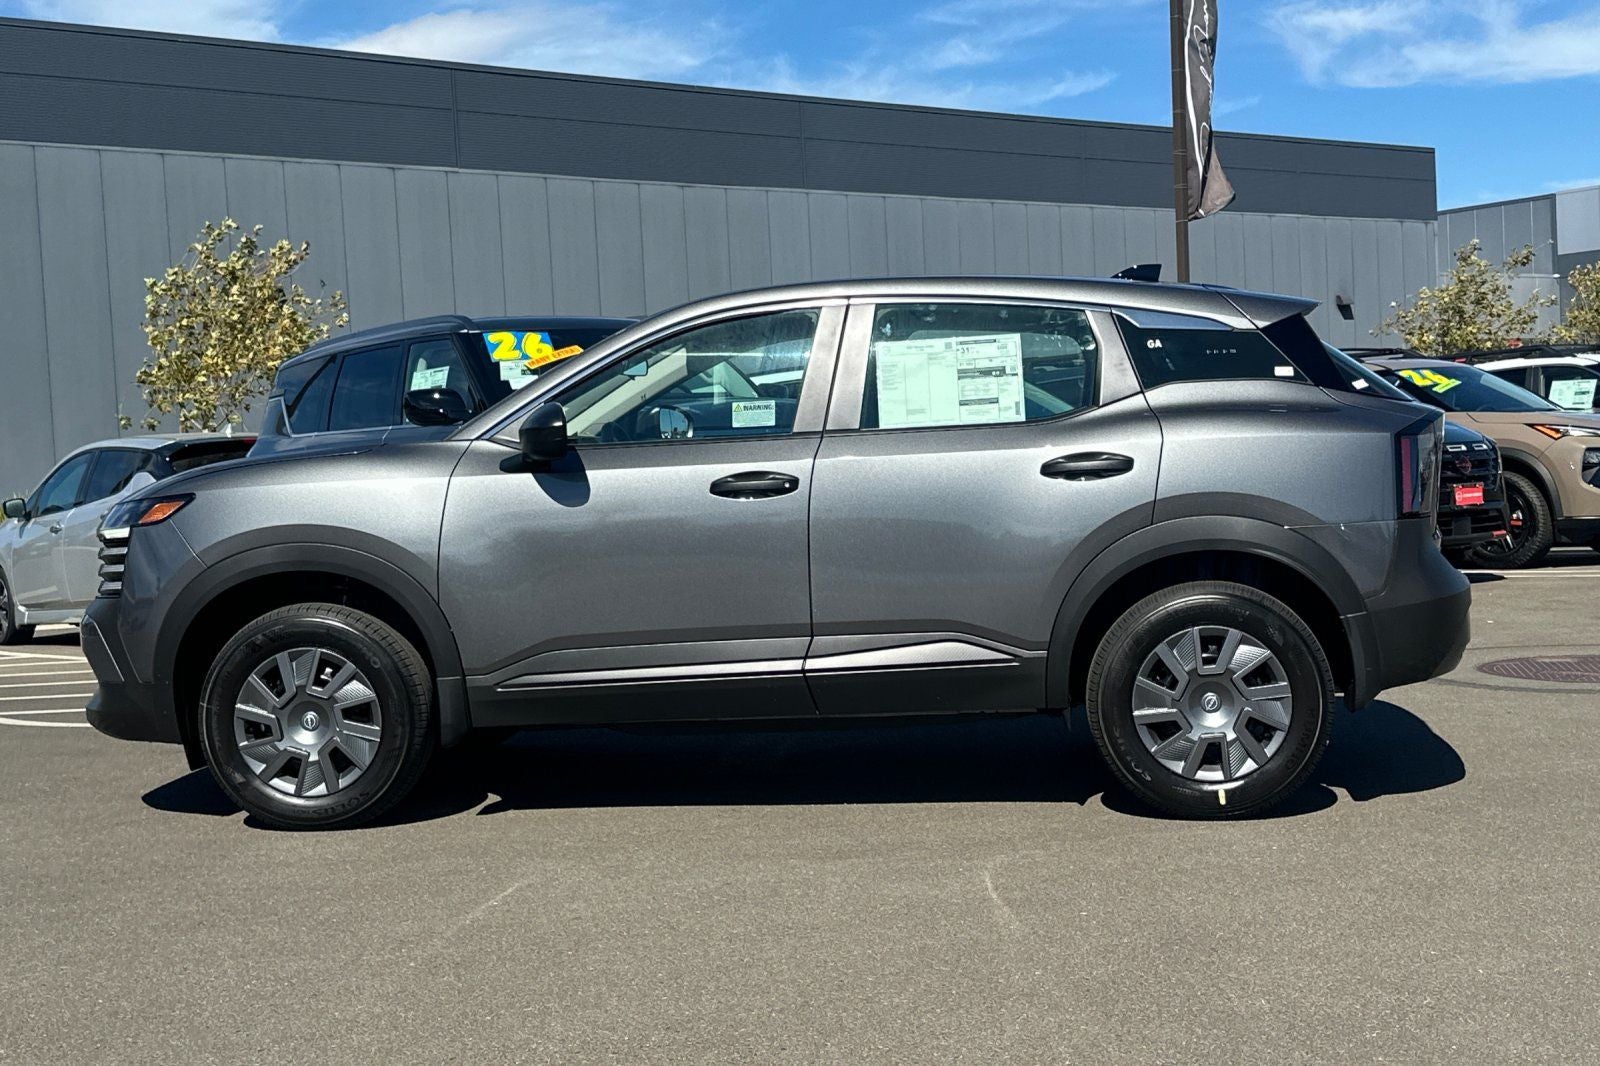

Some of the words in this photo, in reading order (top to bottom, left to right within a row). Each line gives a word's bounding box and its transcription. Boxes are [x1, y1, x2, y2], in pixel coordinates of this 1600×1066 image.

[488, 332, 554, 360] 26
[1147, 339, 1163, 348] GA
[743, 404, 774, 412] WARNING
[312, 792, 370, 816] SOLUS
